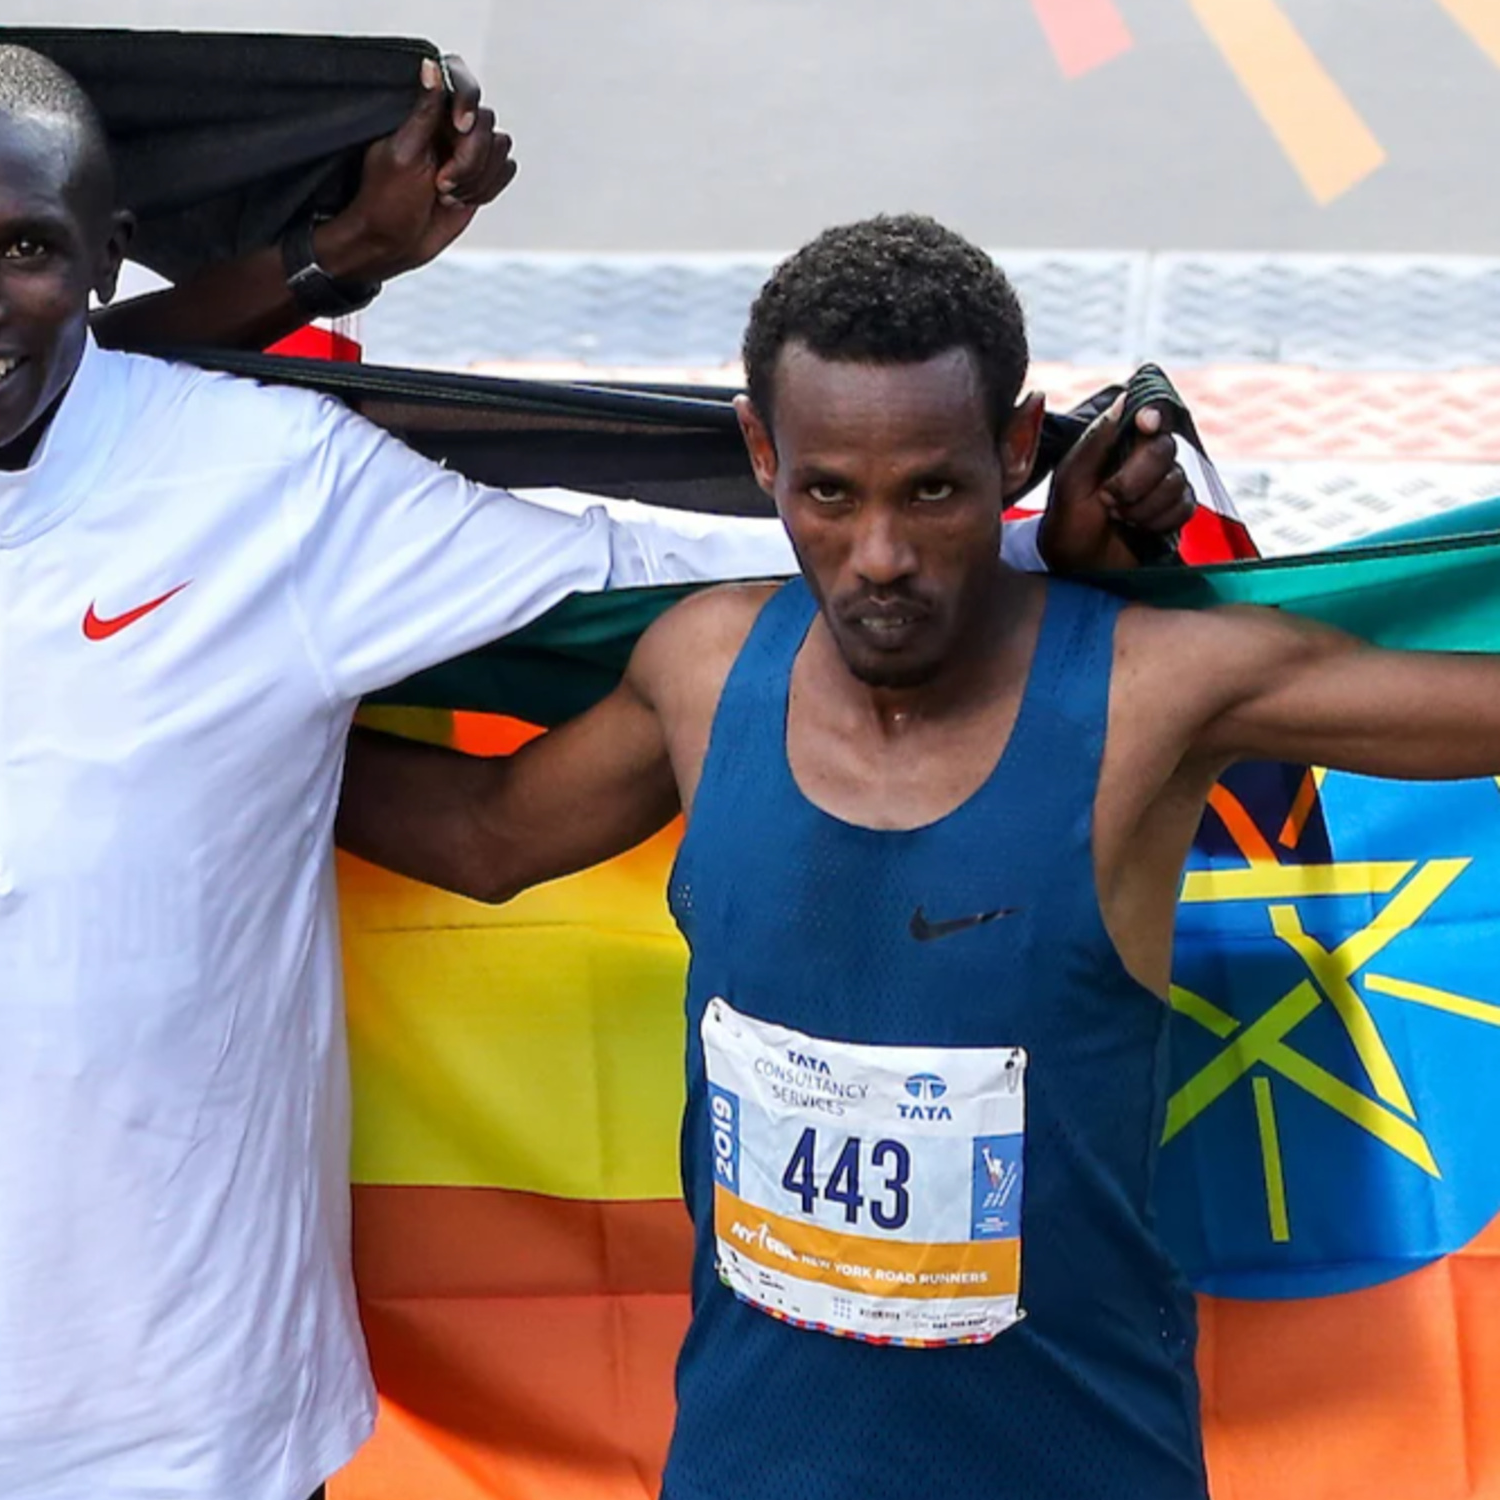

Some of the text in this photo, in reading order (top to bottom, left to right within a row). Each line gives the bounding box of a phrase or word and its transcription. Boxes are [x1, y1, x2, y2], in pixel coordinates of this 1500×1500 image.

[754, 1057, 869, 1099] CONSULTANCY
[787, 1049, 831, 1076] TATA
[772, 1084, 846, 1117] SERVICES
[897, 1104, 952, 1121] TATA
[712, 1095, 734, 1182] 2019
[781, 1127, 911, 1231] 443
[802, 1254, 831, 1270] NEW
[833, 1261, 873, 1280] YORK
[875, 1269, 916, 1285] ROAD
[919, 1271, 988, 1285] RUNNERS
